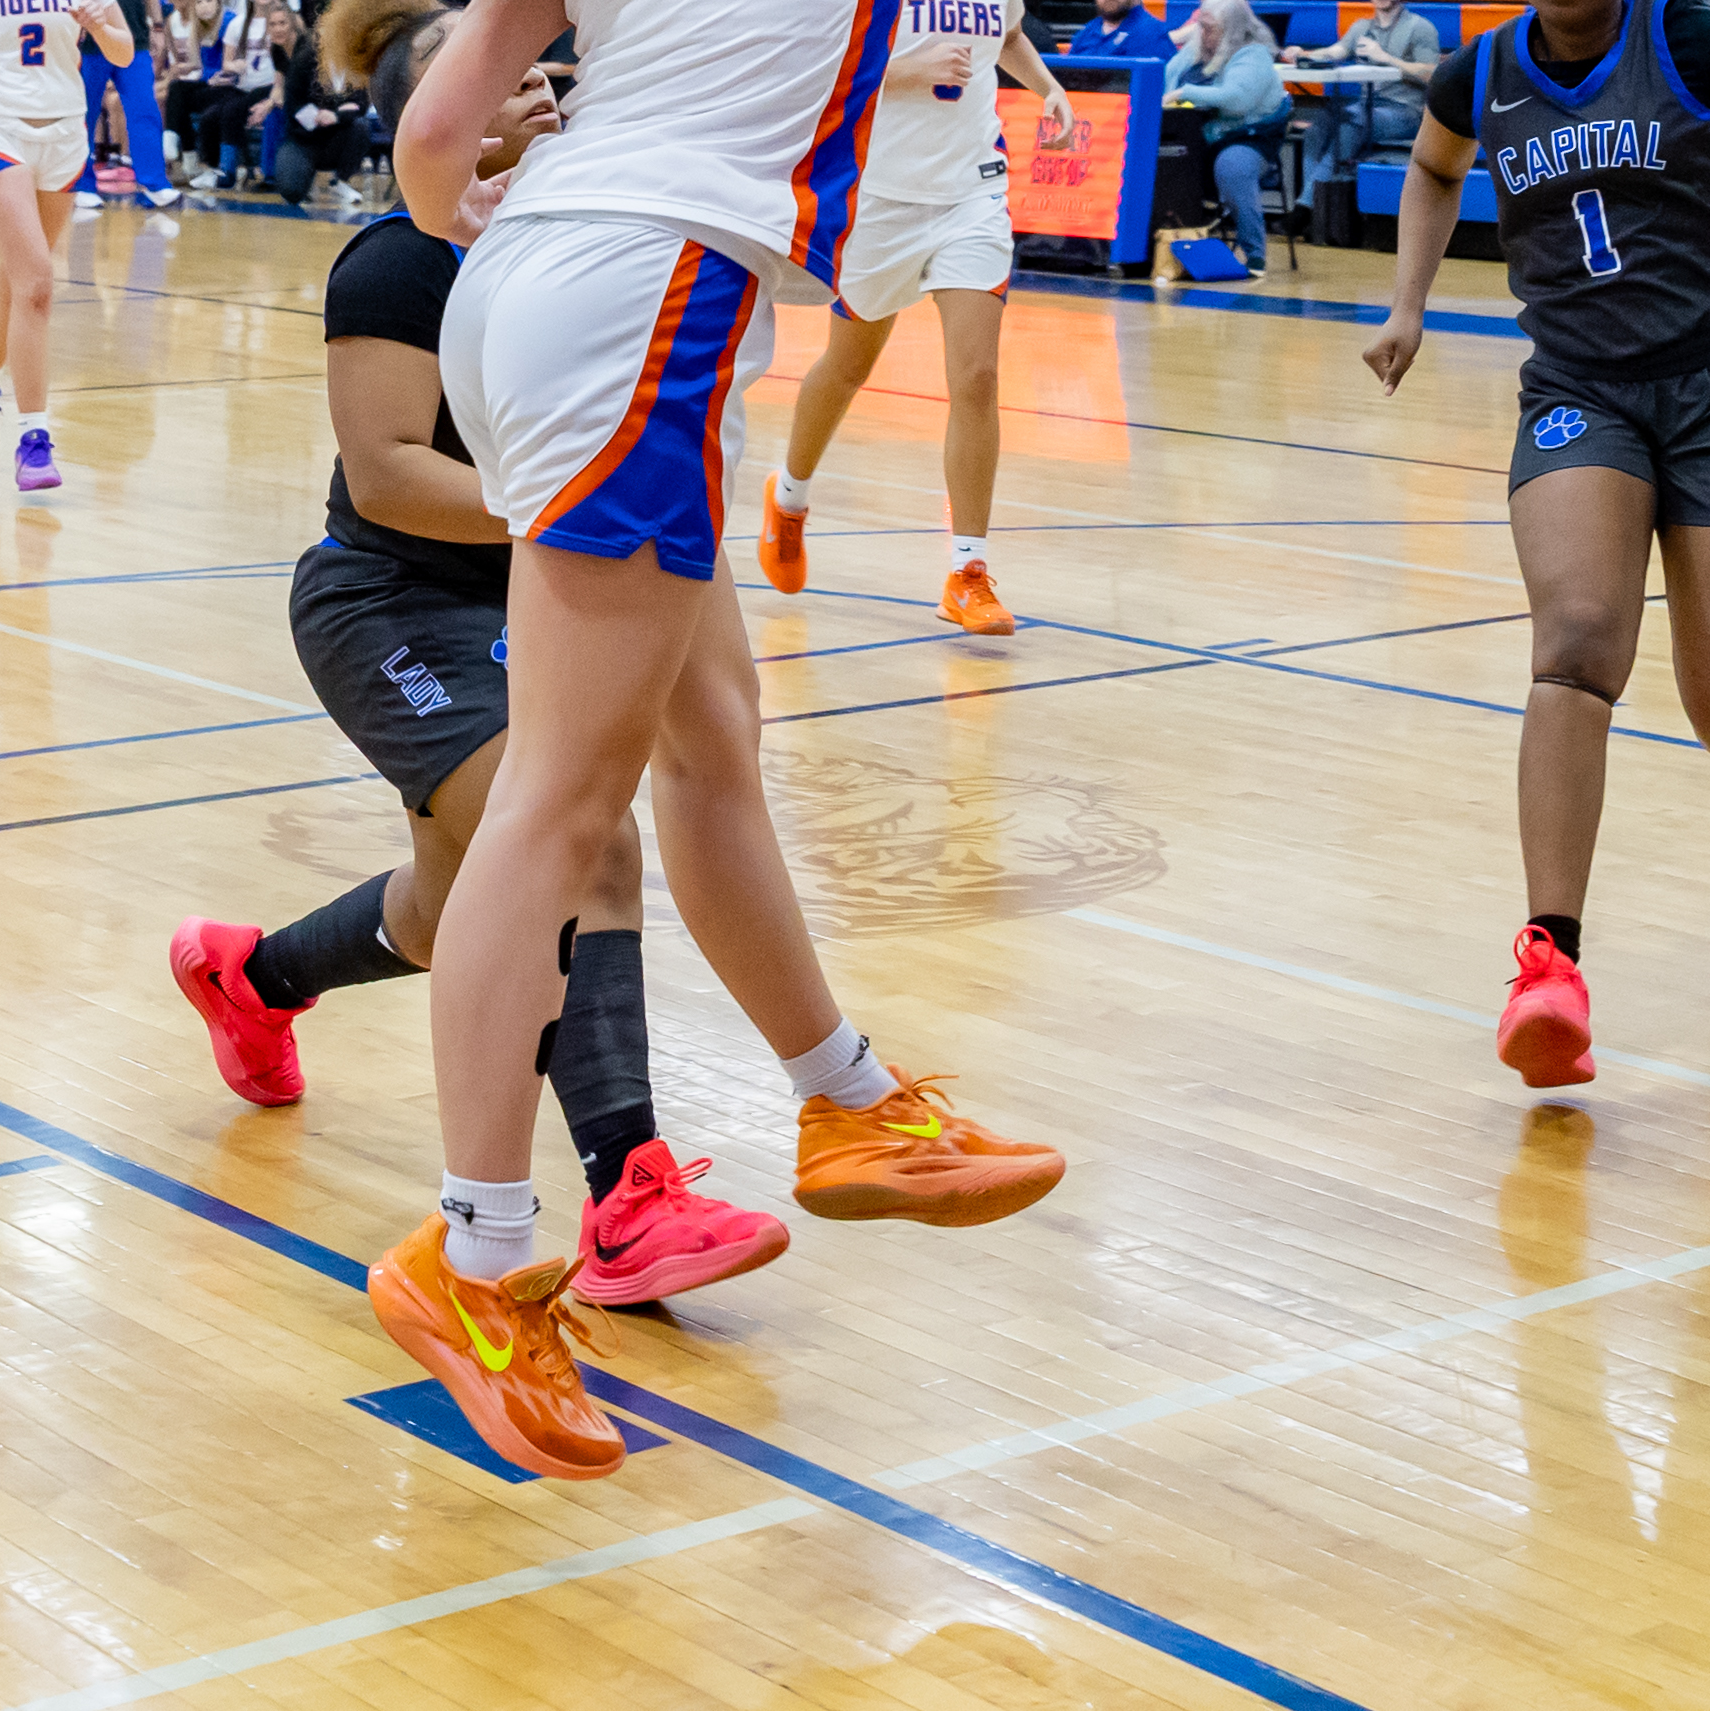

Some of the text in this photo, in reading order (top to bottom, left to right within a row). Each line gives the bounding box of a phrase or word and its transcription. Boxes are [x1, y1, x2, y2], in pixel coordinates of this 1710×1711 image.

[18, 22, 45, 67] 2
[1496, 119, 1668, 196] CAPITAL
[1571, 188, 1622, 278] 1
[380, 645, 452, 718] LADY
